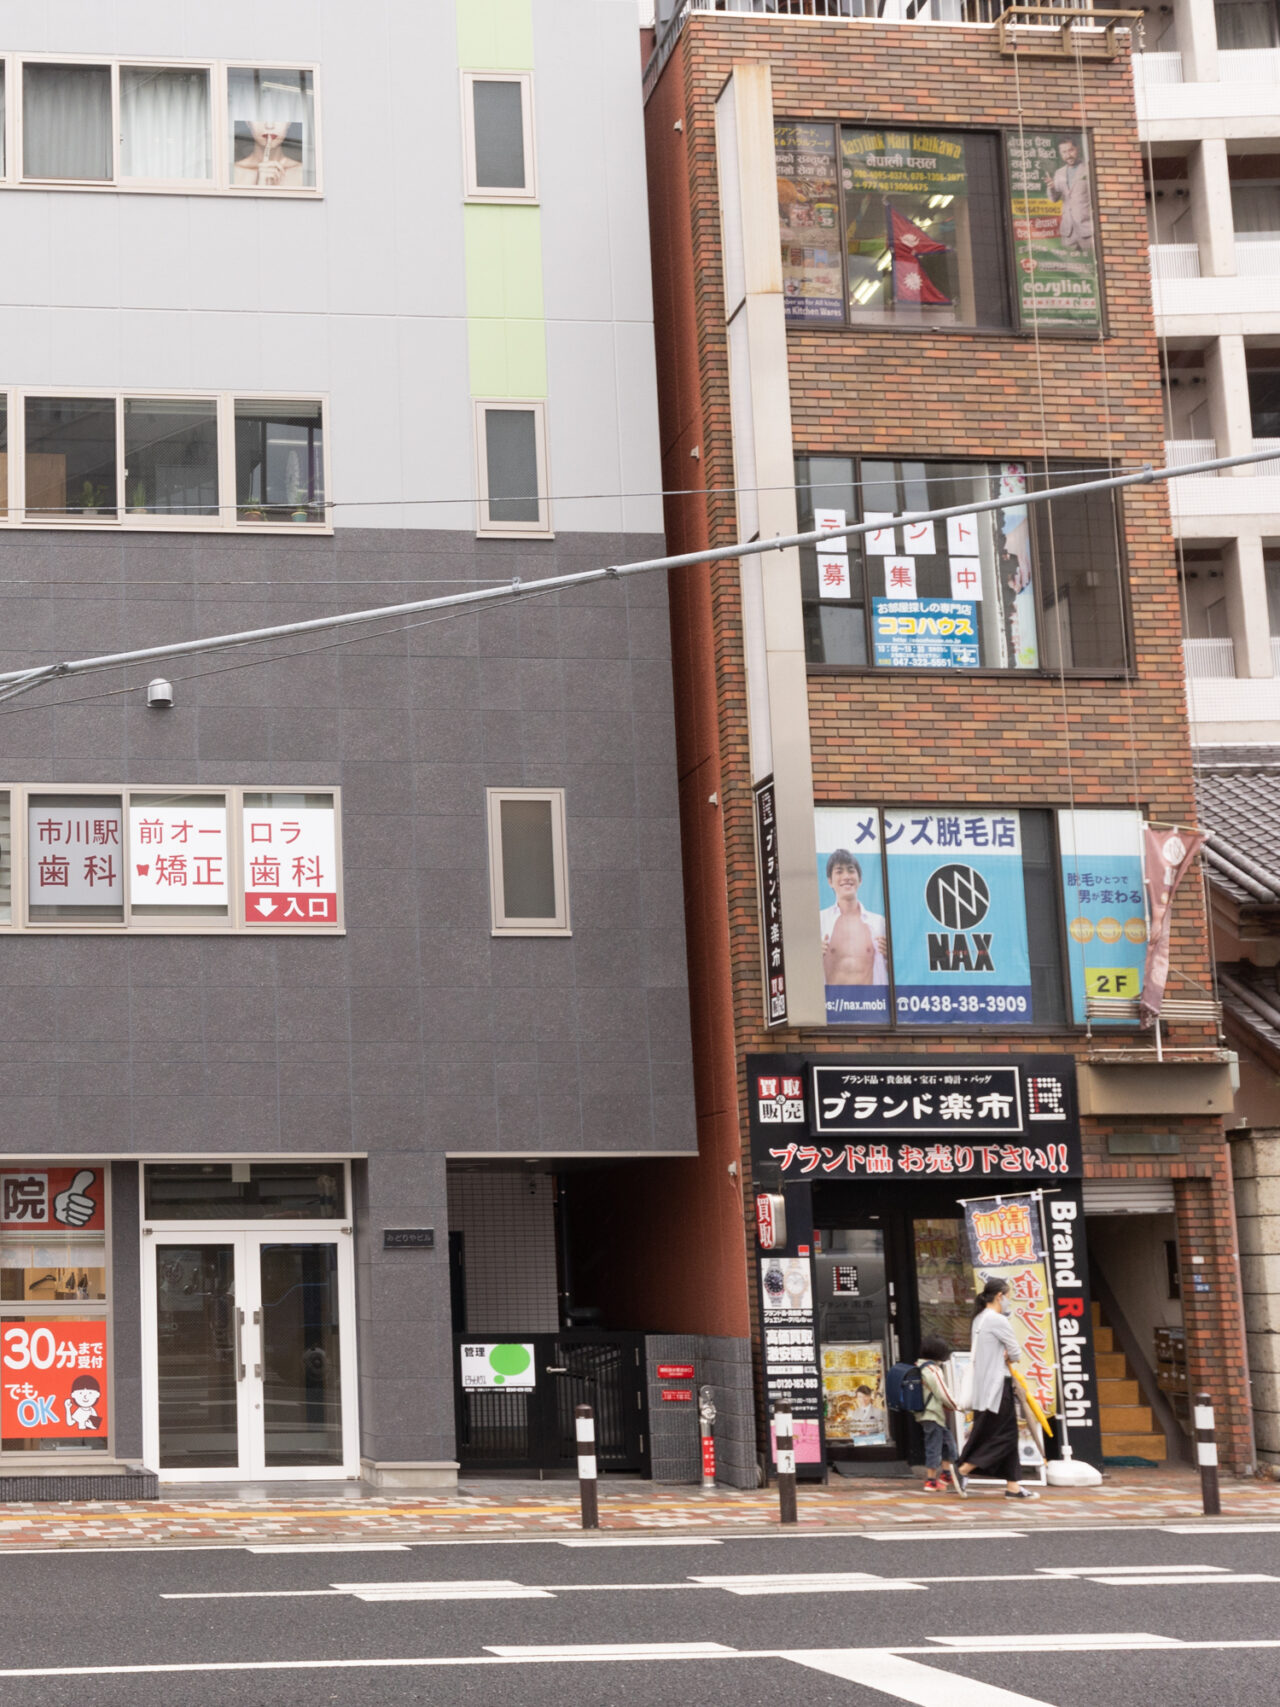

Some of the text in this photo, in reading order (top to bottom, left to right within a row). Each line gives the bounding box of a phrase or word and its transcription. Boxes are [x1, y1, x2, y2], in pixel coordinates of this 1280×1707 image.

[1023, 279, 1093, 296] easylink
[823, 563, 977, 589] 募集中
[877, 602, 972, 616] お部屋探しの専門店
[878, 616, 974, 635] ココハウス
[854, 816, 1017, 847] メンズ脱毛店
[37, 854, 117, 888] 歯科
[1067, 872, 1128, 886] 脱毛ひとつで
[1078, 890, 1142, 904] 男が変わる
[283, 896, 329, 918] 入口
[927, 933, 995, 971] NAX
[910, 995, 1027, 1013] 0438-38-3909
[760, 1079, 800, 1096] 買取
[762, 1103, 802, 1119] 販売
[823, 1091, 1014, 1120] ブランド楽市
[770, 1143, 1069, 1173] ブランド品 お売り下さい!!
[1050, 1200, 1093, 1428] Brand Rakuichi
[766, 1329, 813, 1345] 高価買取
[4, 1328, 78, 1369] 30分
[78, 1343, 103, 1355] まで
[464, 1347, 485, 1357] 管理
[78, 1356, 103, 1369] 受付
[5, 1383, 38, 1400] でも
[17, 1394, 61, 1427] OK
